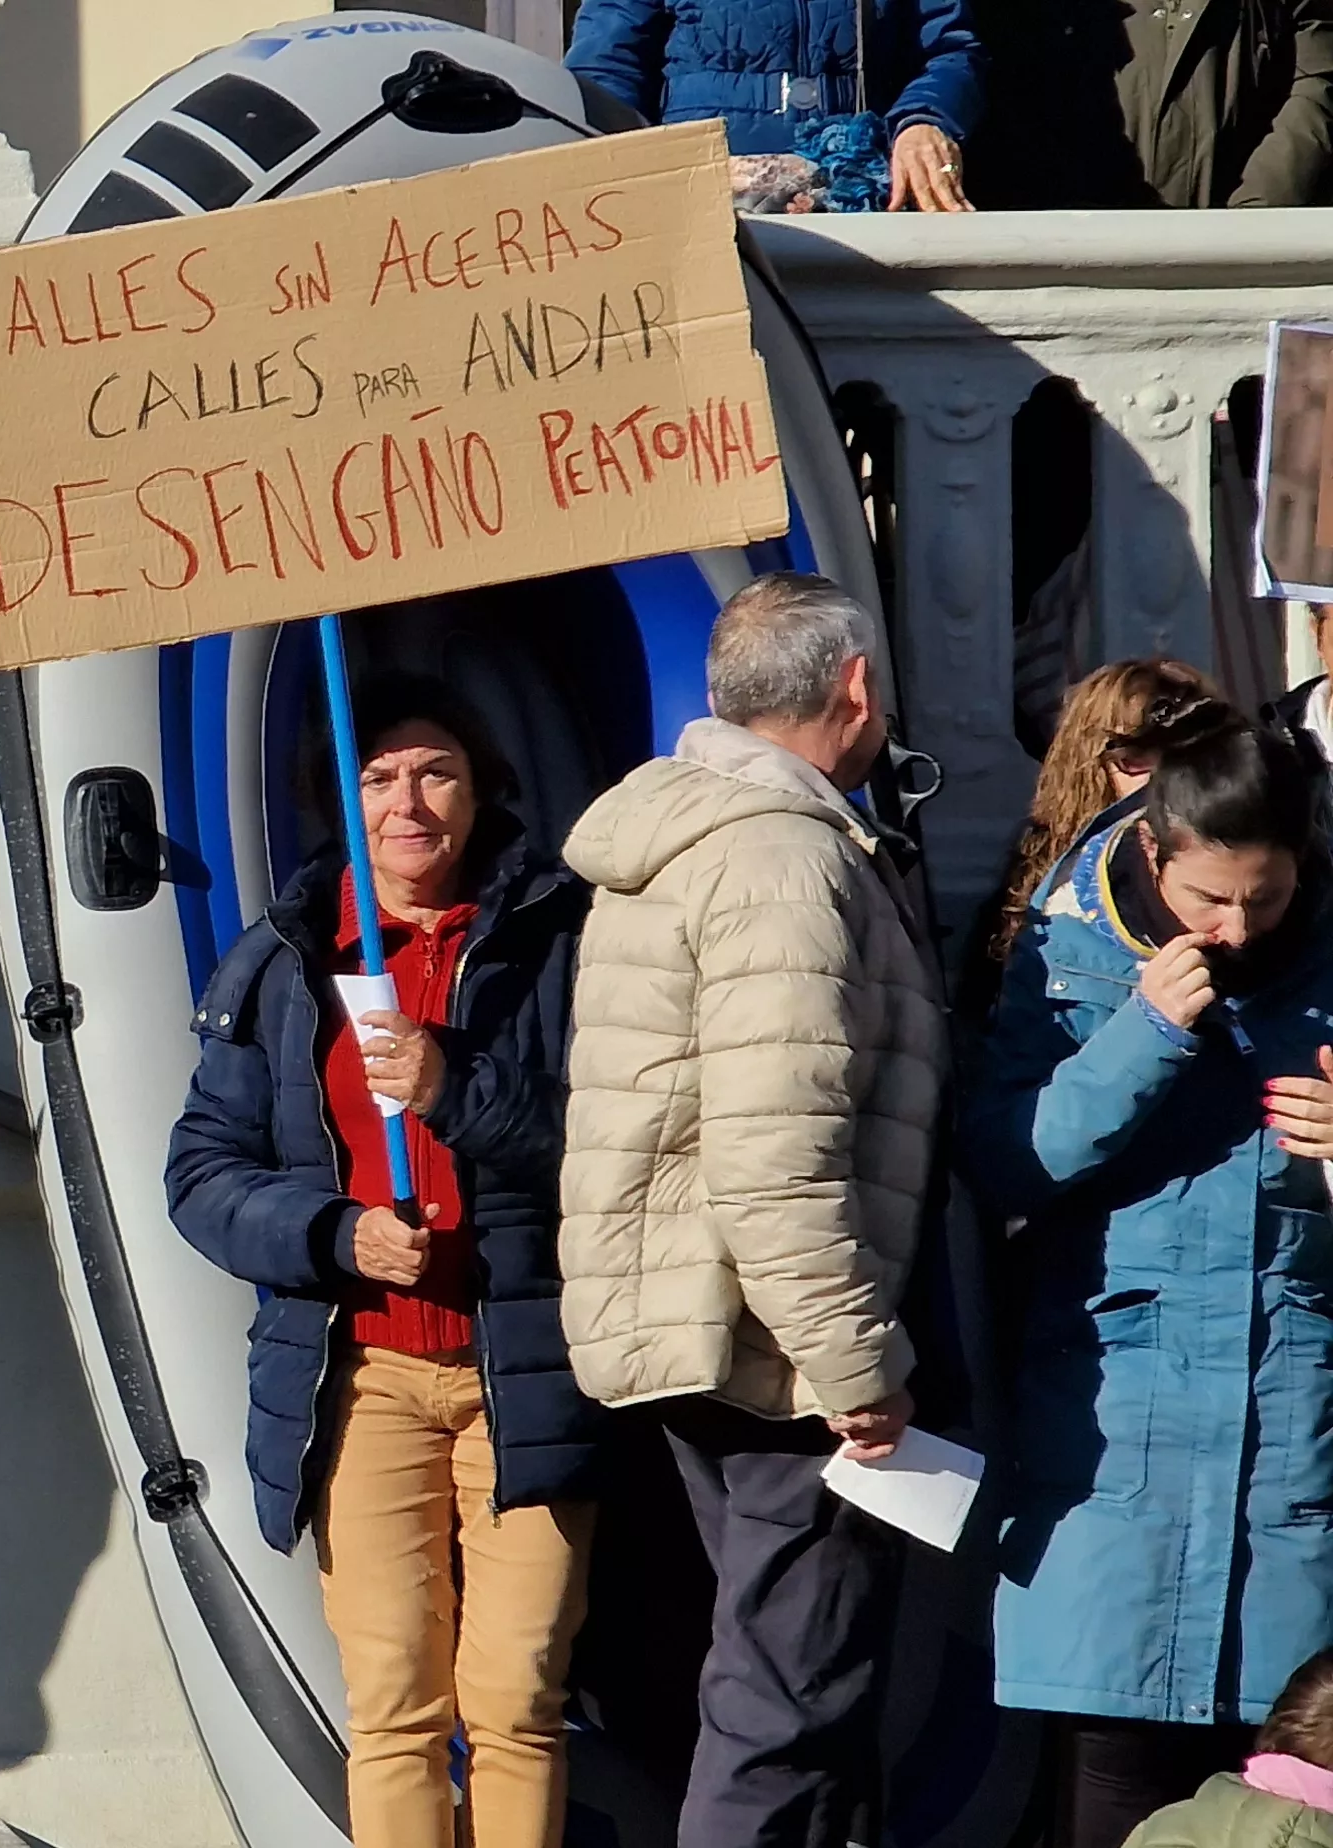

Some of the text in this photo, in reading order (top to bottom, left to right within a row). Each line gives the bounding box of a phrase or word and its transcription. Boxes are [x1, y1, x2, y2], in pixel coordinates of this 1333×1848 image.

[269, 240, 332, 315] SIN
[370, 190, 626, 307] ACERAS
[86, 281, 681, 439] CALLES PARA ANDAR
[537, 395, 782, 511] PEATONAL
